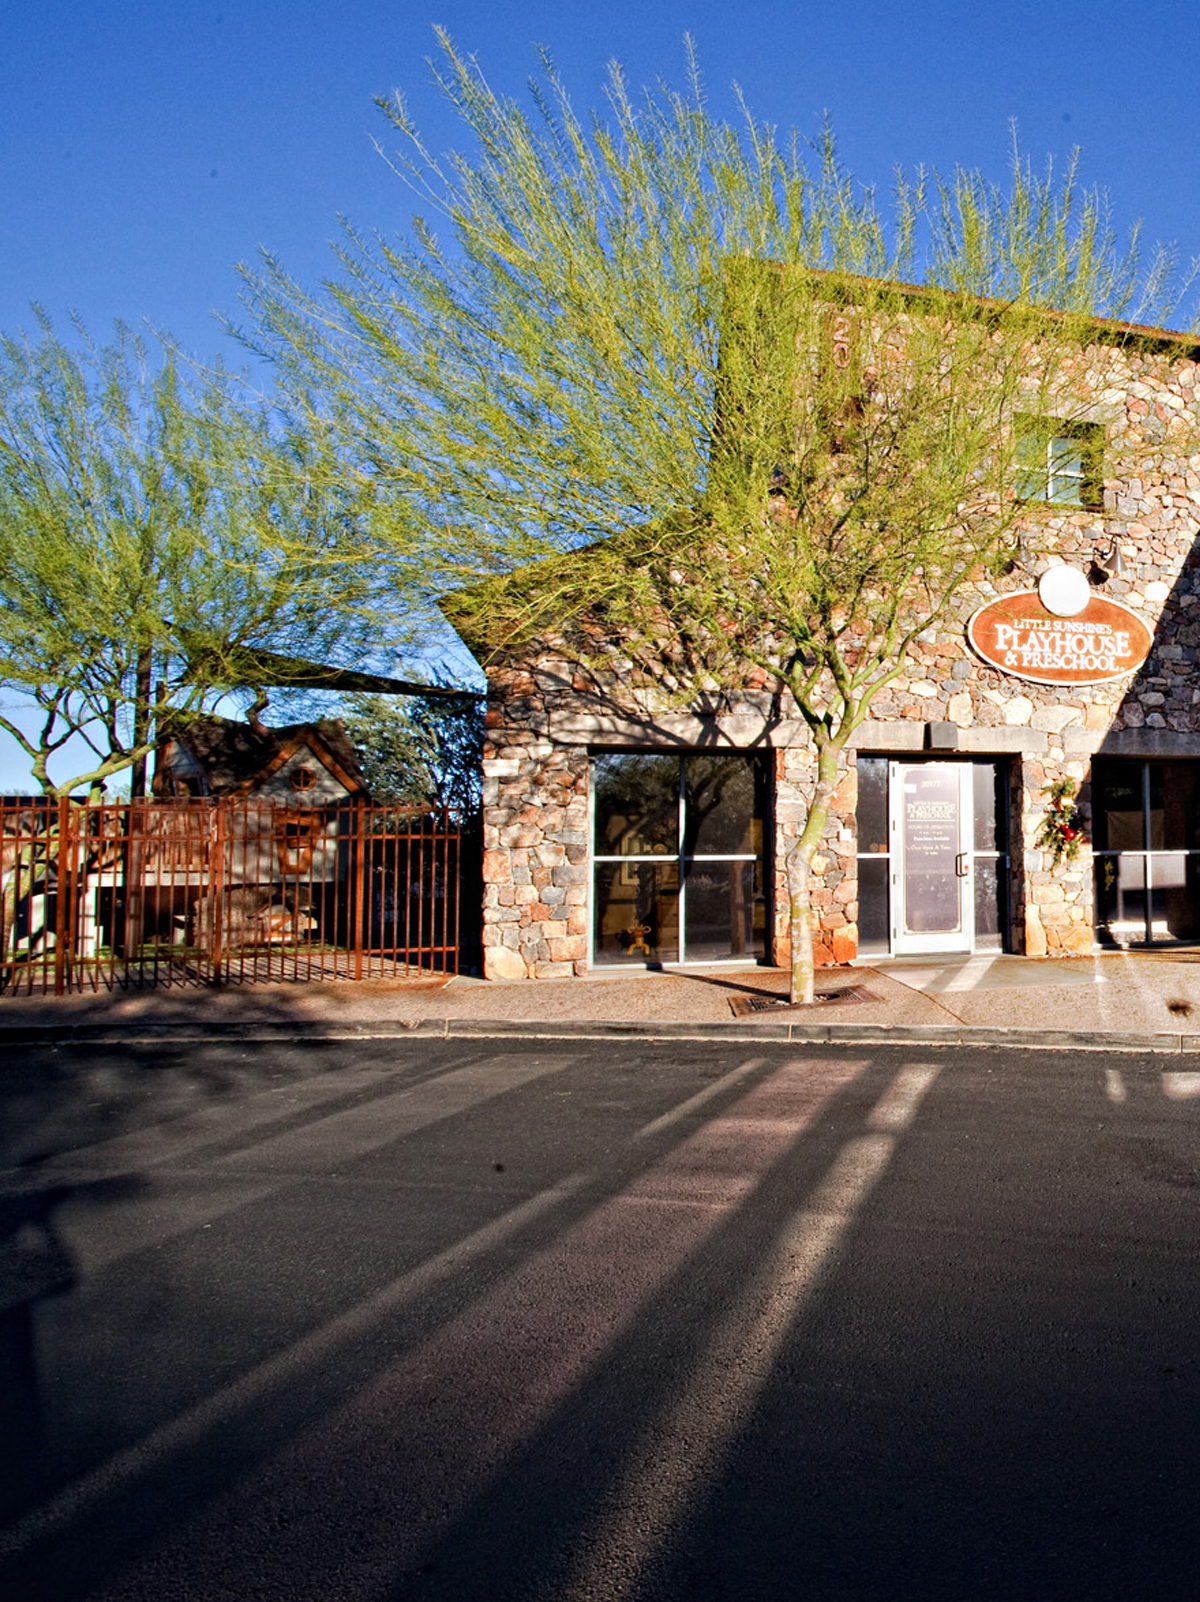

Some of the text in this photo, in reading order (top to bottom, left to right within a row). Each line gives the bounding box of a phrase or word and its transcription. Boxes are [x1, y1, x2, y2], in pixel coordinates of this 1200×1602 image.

[1013, 618, 1113, 634] LITTLE SUNSHINE'S
[994, 624, 1132, 657] PLAYHOUSE
[1004, 650, 1018, 666] &
[906, 803, 957, 814] PLAYHOUSE
